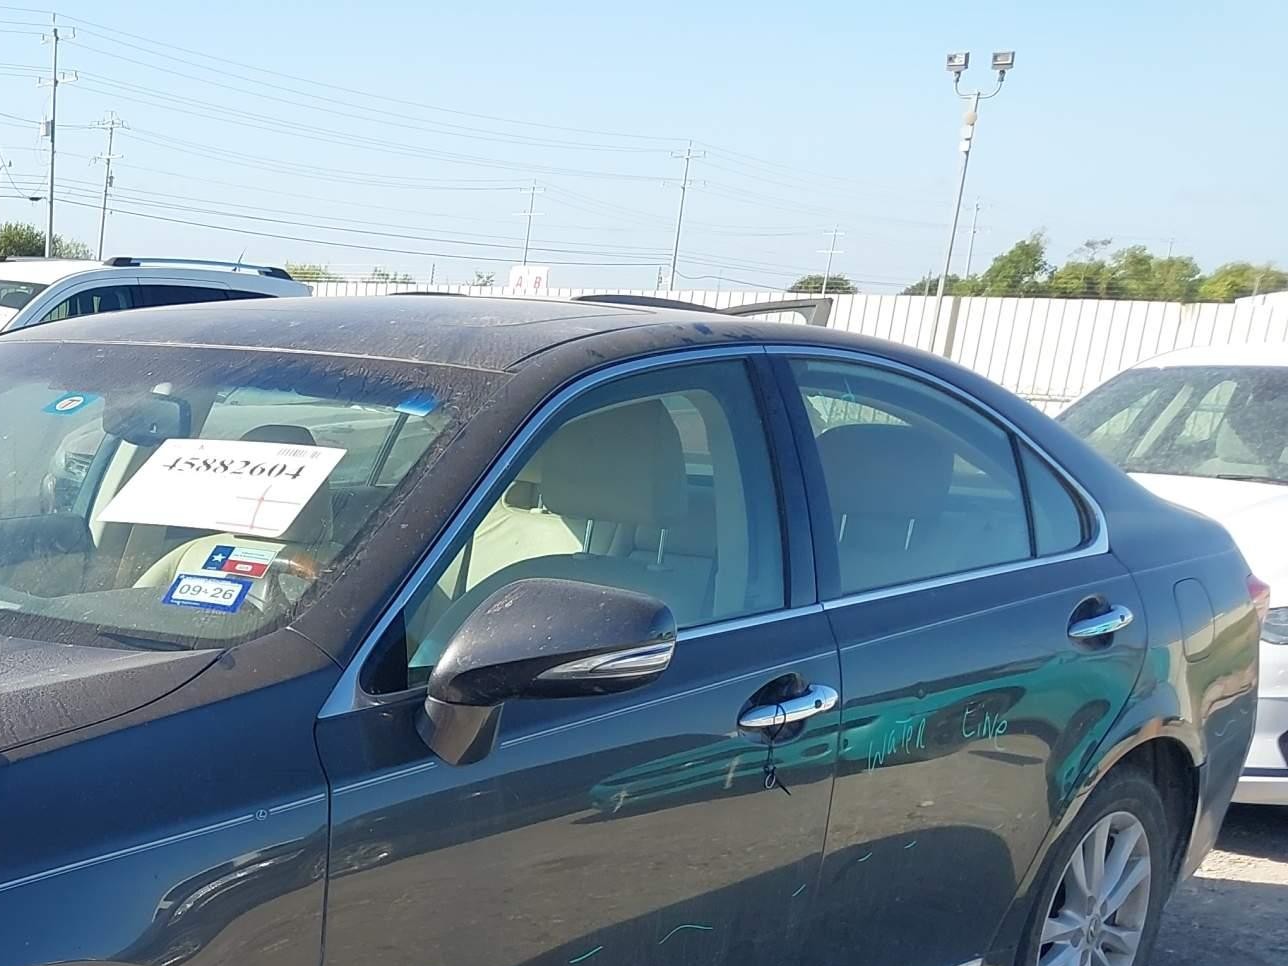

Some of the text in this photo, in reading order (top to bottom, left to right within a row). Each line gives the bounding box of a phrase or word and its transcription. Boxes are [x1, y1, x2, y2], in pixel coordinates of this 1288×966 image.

[162, 456, 306, 481] 45882604
[178, 583, 235, 600] 09 26
